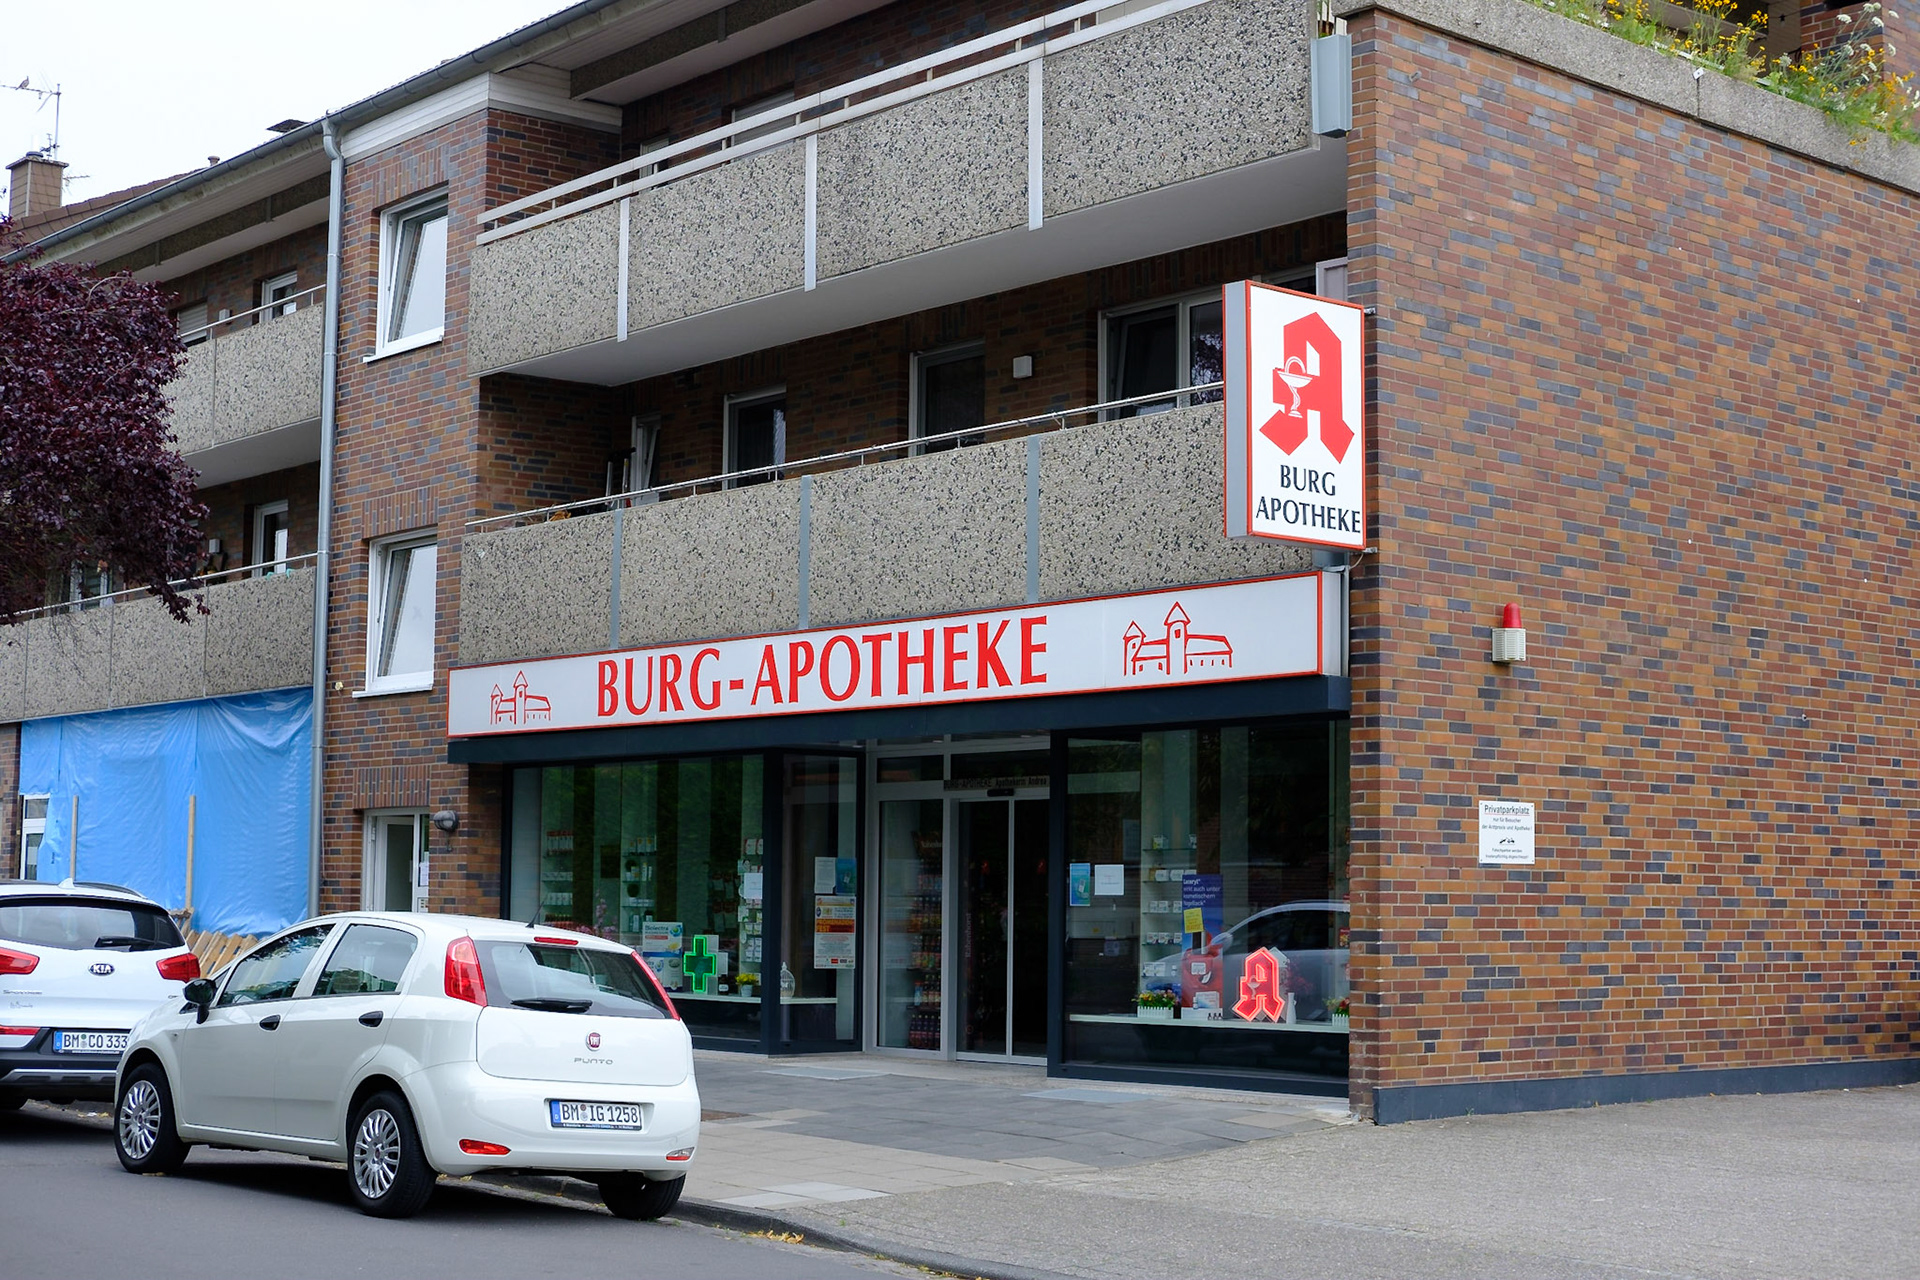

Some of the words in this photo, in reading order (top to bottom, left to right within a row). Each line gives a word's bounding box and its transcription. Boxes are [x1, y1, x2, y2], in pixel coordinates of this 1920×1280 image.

[1280, 464, 1336, 496] BURG
[1256, 496, 1361, 533] APOTHEKE
[597, 615, 1048, 718] BURG-APOTHEKE
[1484, 804, 1530, 815] Privatparkplatz
[93, 964, 111, 973] KIA
[64, 1035, 79, 1047] BM
[89, 1035, 103, 1048] CO
[562, 1104, 579, 1121] BM
[590, 1106, 604, 1122] IG
[607, 1106, 638, 1123] 1258
